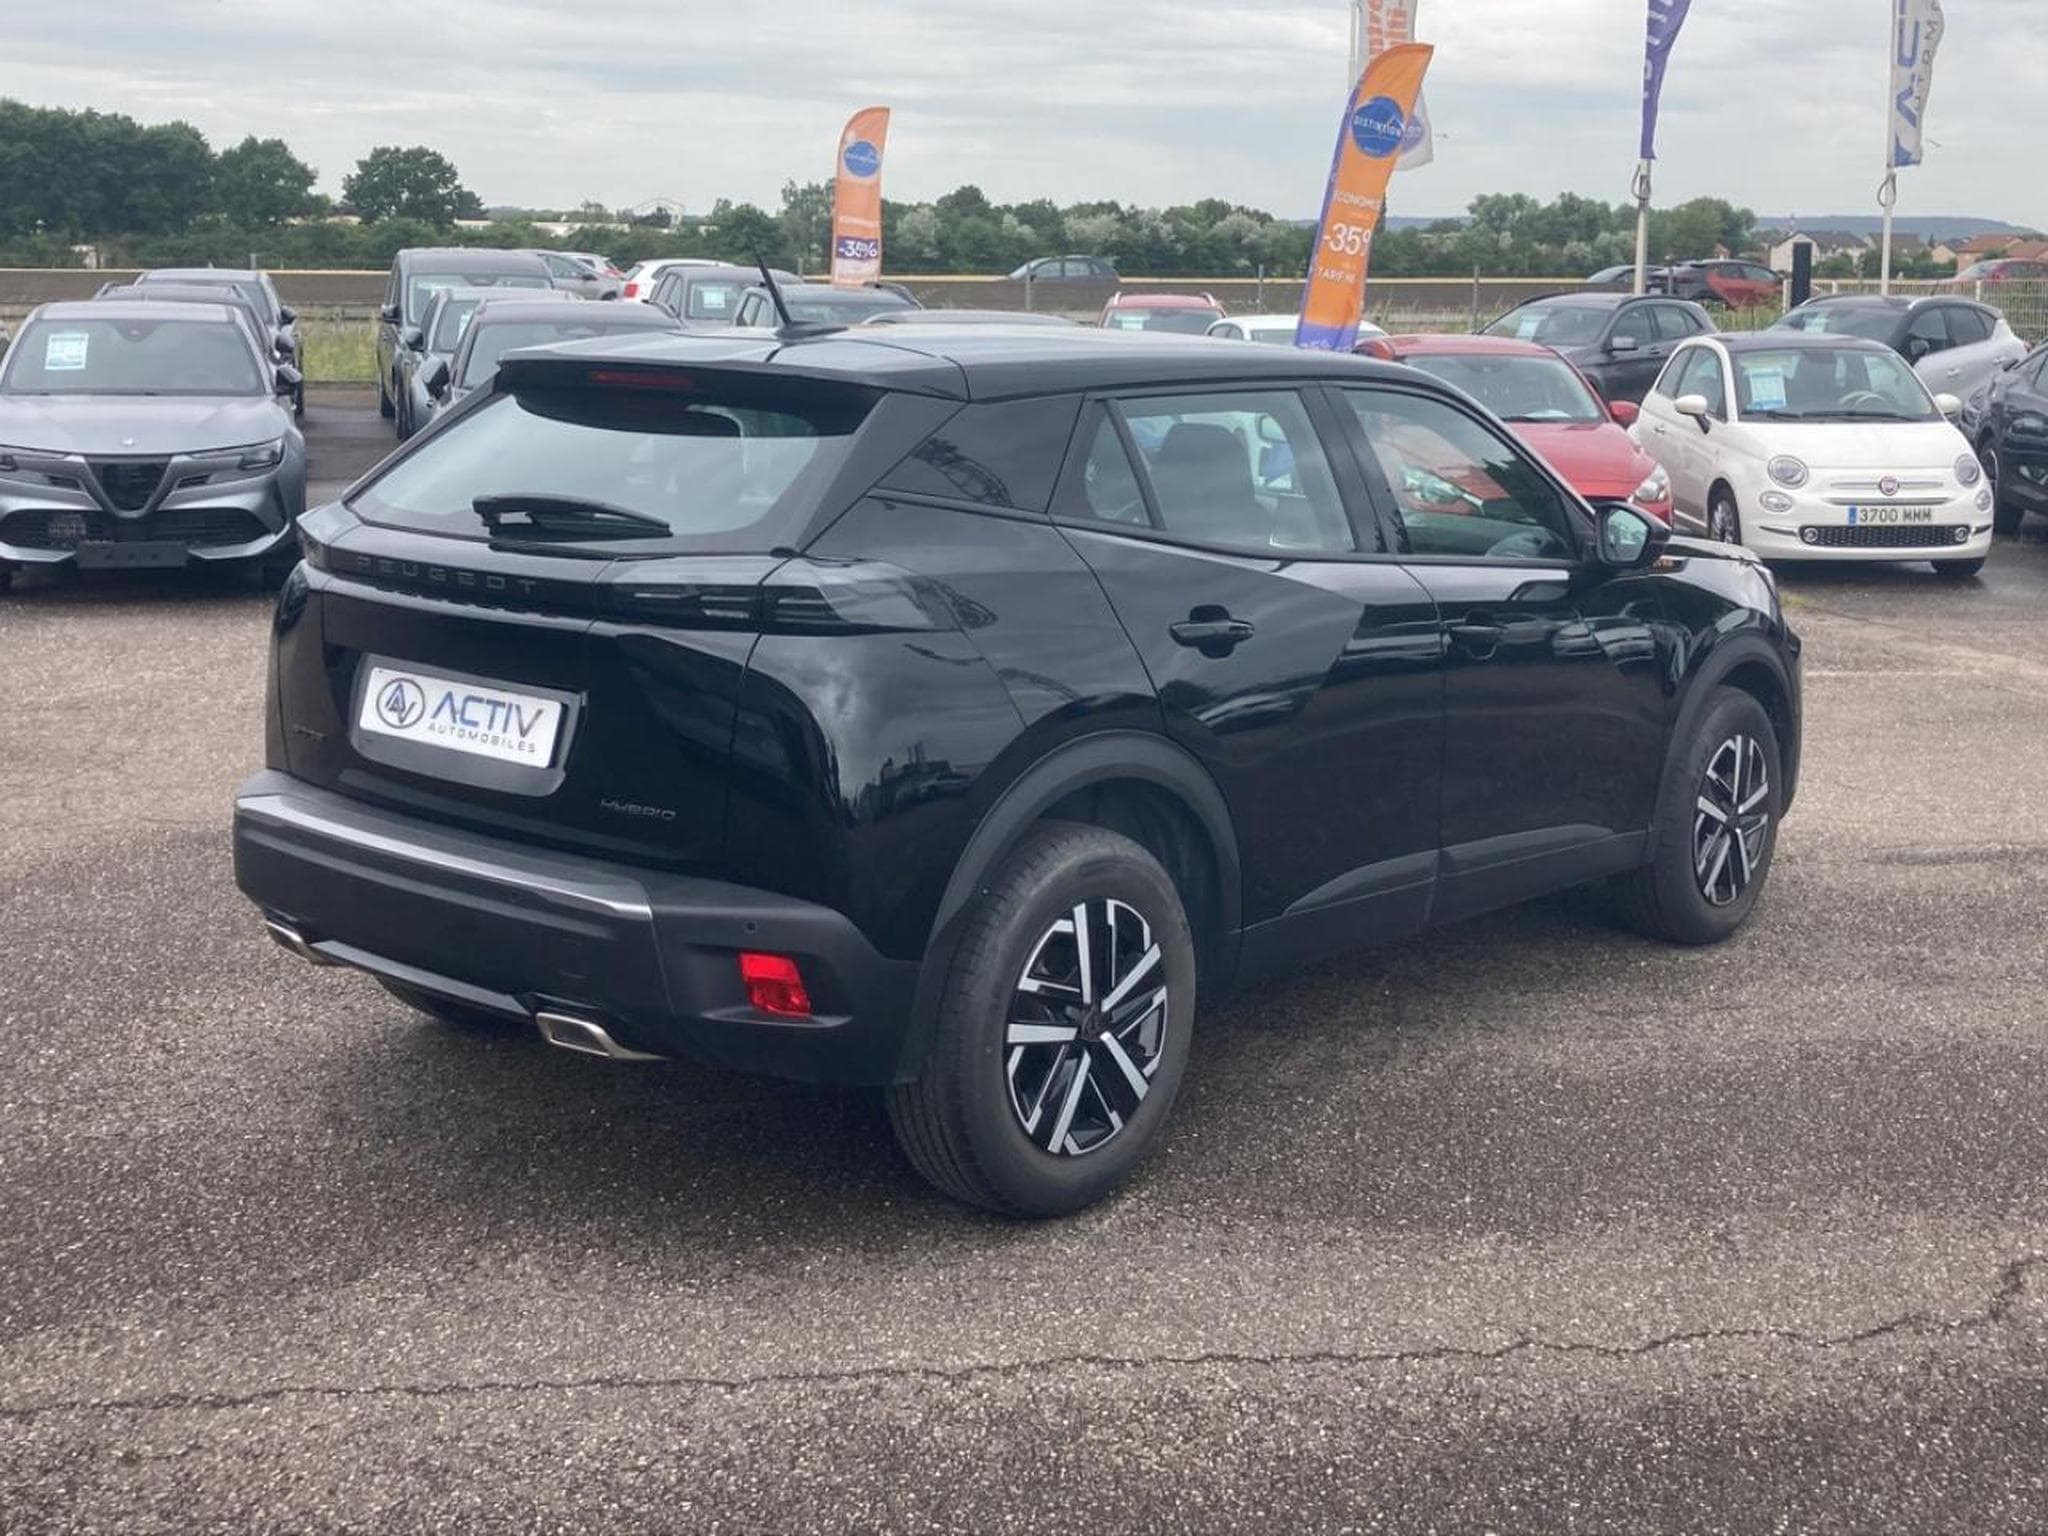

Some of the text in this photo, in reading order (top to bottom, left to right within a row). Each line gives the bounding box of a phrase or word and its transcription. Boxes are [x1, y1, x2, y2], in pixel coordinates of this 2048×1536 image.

[1860, 507, 1899, 523] 3700
[357, 555, 537, 593] PEUGEOT
[431, 691, 543, 738] ACTIV
[427, 723, 537, 754] AUTOMOBILES
